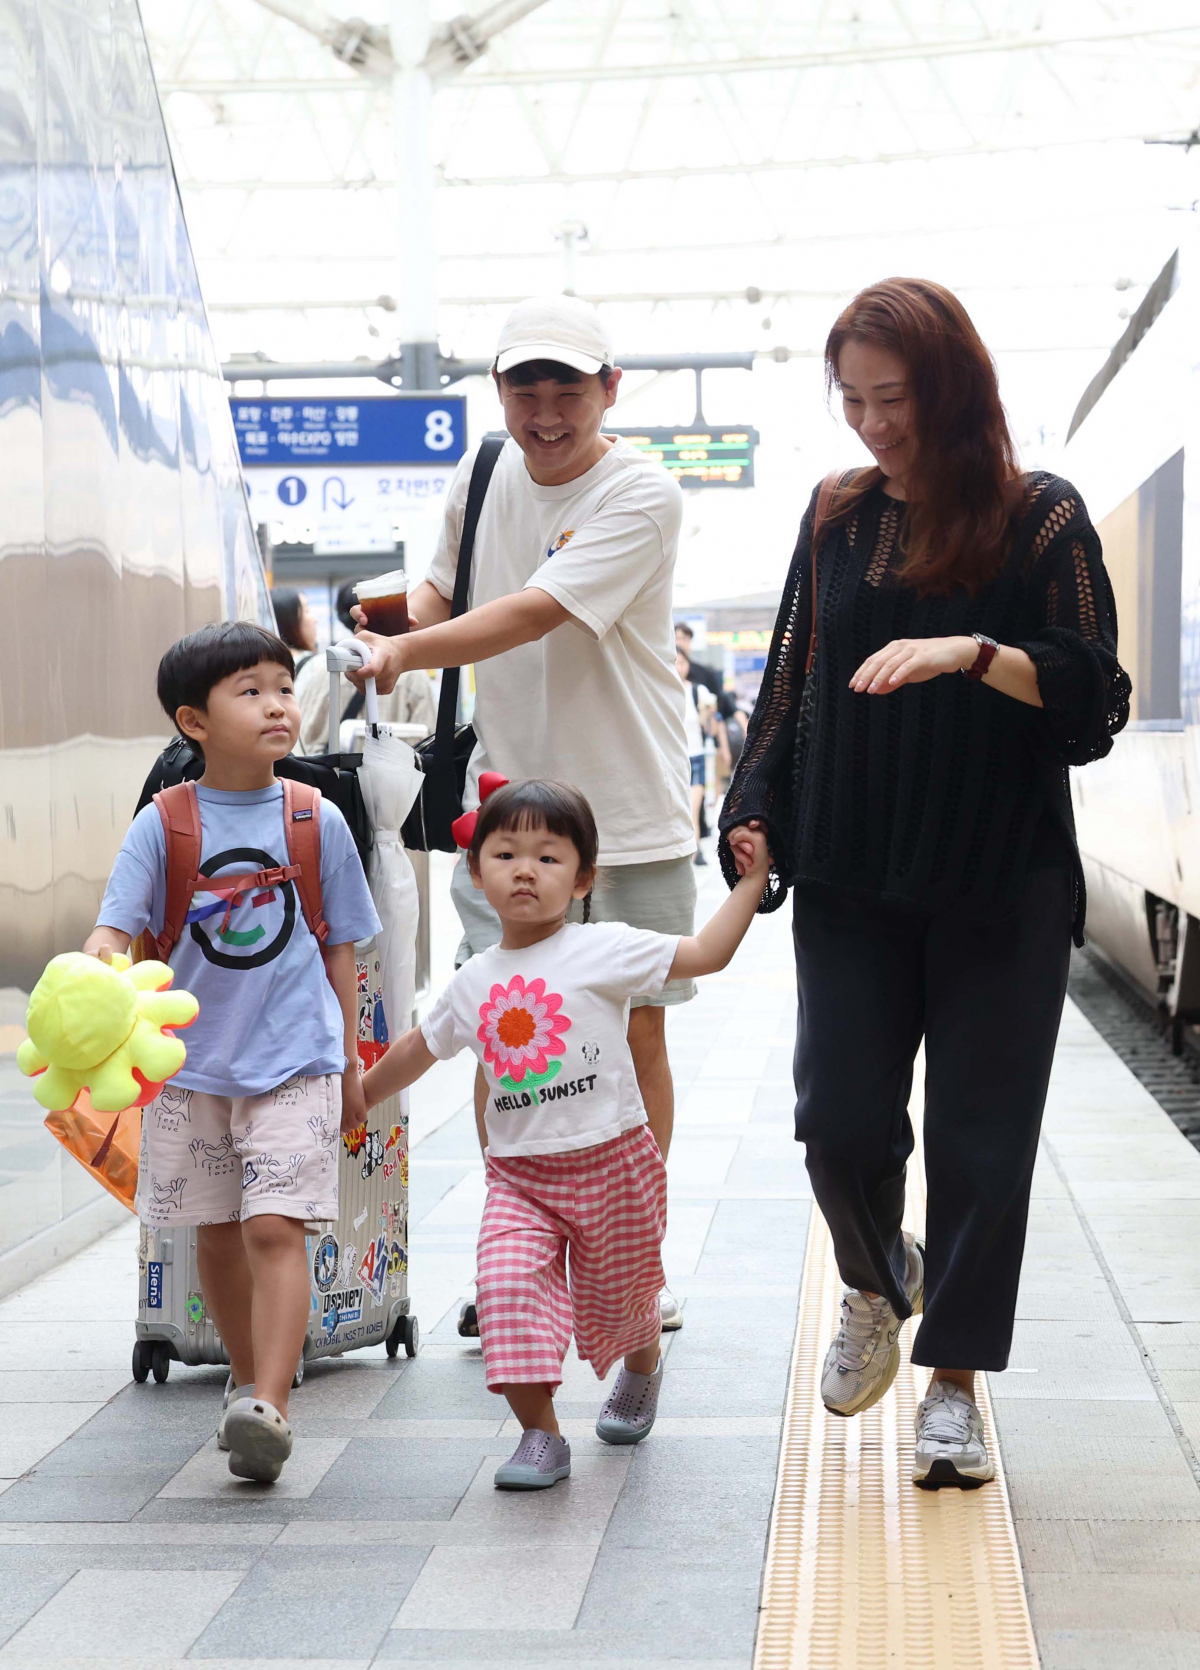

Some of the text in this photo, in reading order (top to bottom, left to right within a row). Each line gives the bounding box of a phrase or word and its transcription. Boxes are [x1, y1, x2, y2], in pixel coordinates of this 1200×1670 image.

[424, 409, 454, 451] 8
[274, 1090, 298, 1099] feel
[494, 1074, 598, 1113] HELLO SUNSET
[273, 1099, 297, 1107] love
[157, 1113, 180, 1126] feel
[156, 1123, 179, 1133] love
[207, 1160, 234, 1171] feel
[208, 1168, 235, 1177] love
[323, 1287, 363, 1313] Dscovery
